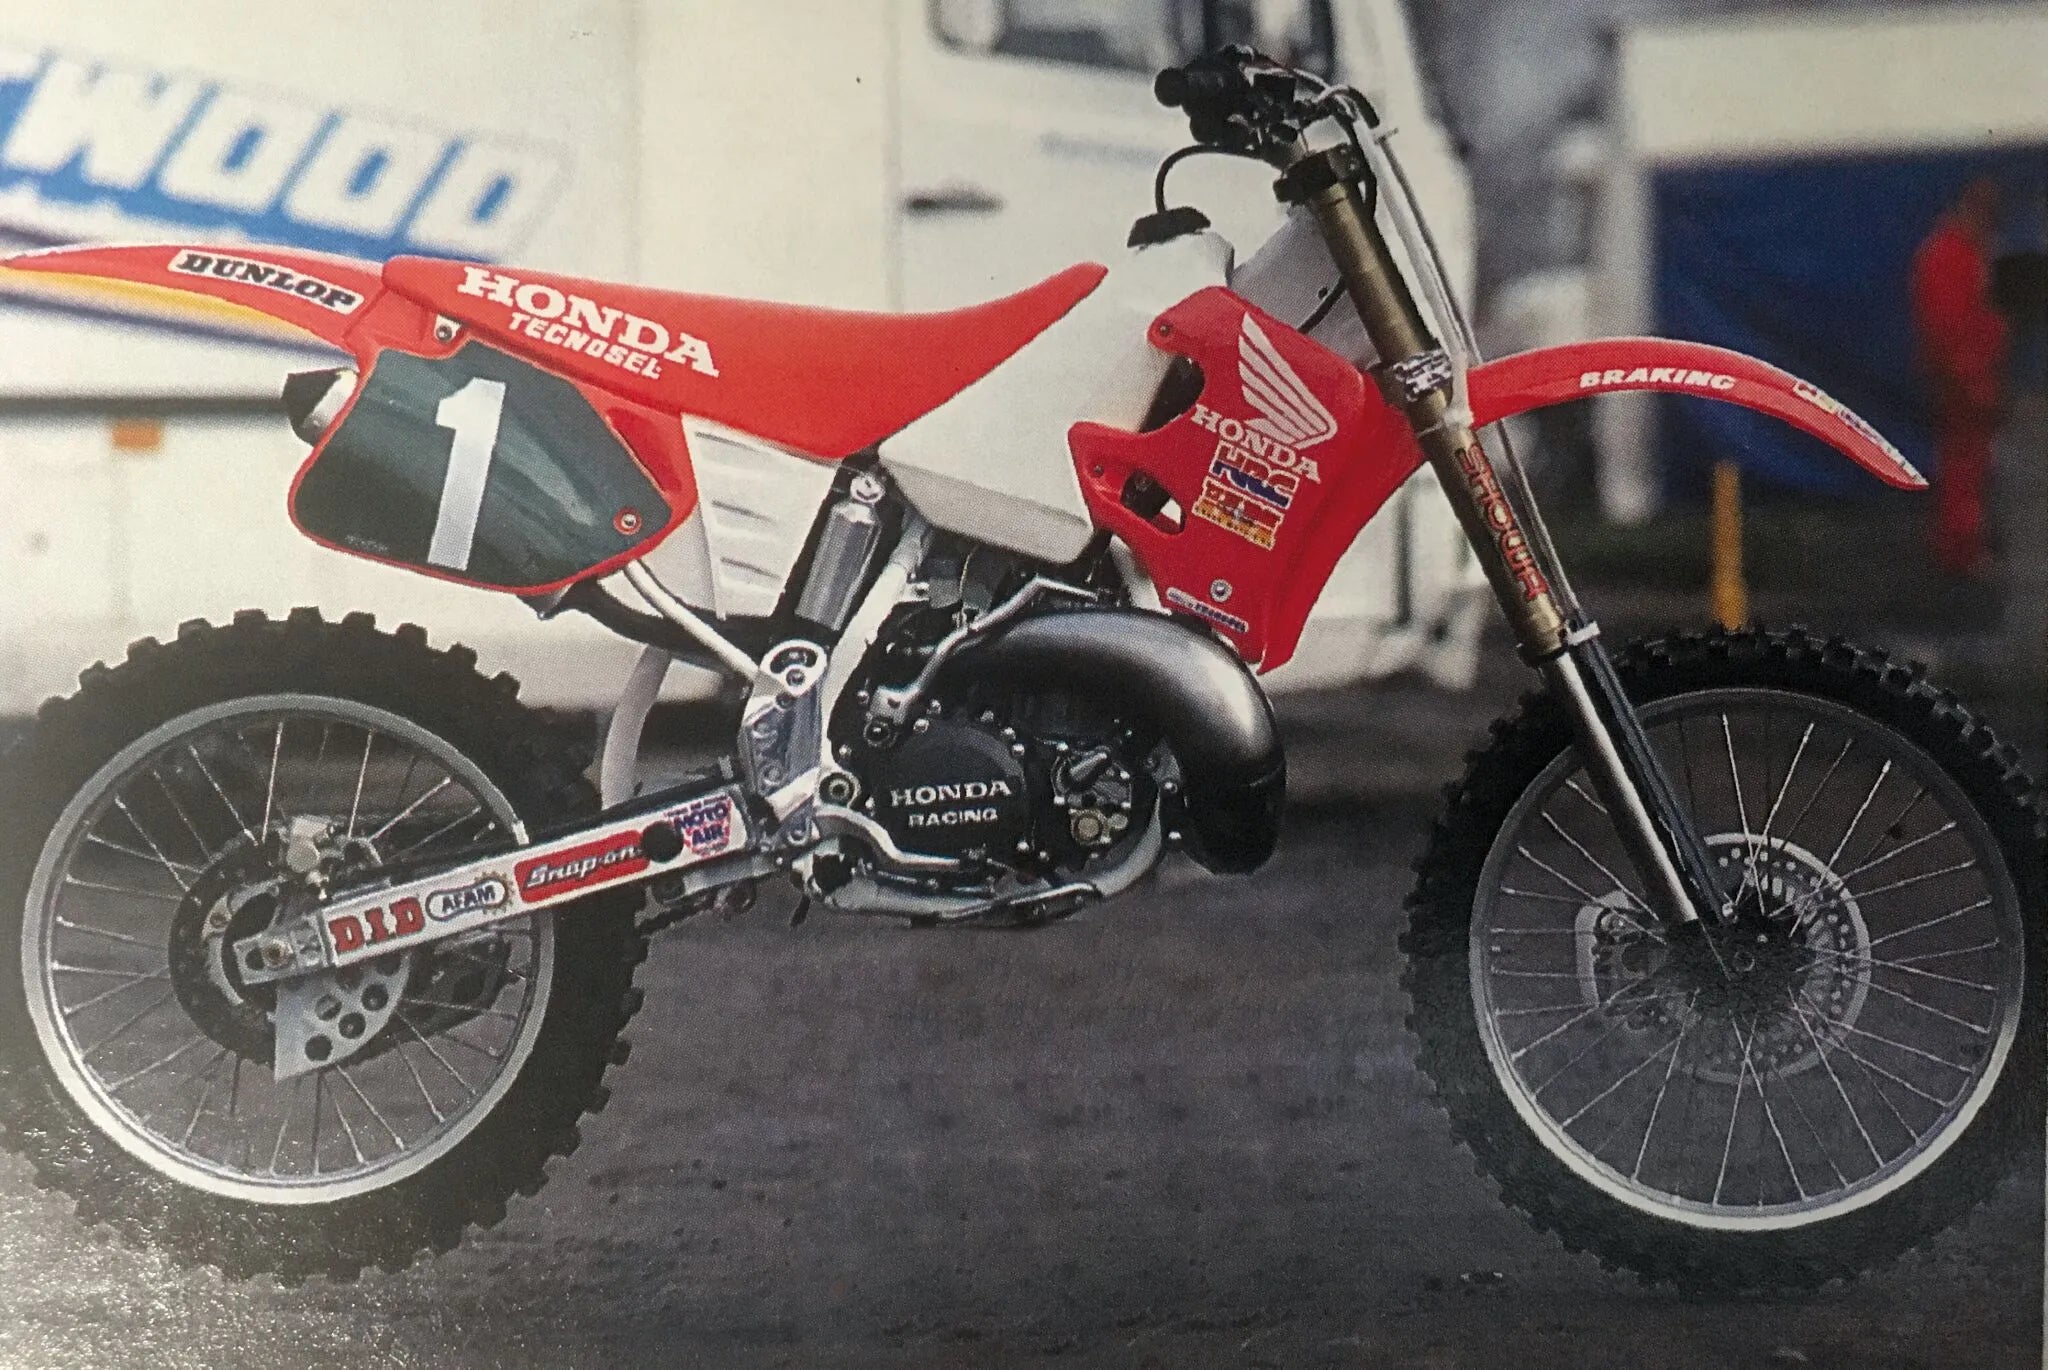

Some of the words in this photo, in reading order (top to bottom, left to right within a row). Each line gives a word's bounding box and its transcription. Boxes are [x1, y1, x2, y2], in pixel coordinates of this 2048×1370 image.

[0, 38, 566, 252] WOOD
[176, 253, 356, 307] DUNLOP
[457, 266, 720, 378] HONDA
[508, 311, 662, 380] TECNOSEL
[1579, 367, 1737, 390] BRAKING
[427, 377, 506, 571] 1
[1190, 404, 1321, 484] HONDA
[1454, 442, 1550, 601] SHOWA
[890, 780, 1012, 807] HONDA
[908, 807, 998, 828] RACING
[442, 885, 496, 913] AFAM
